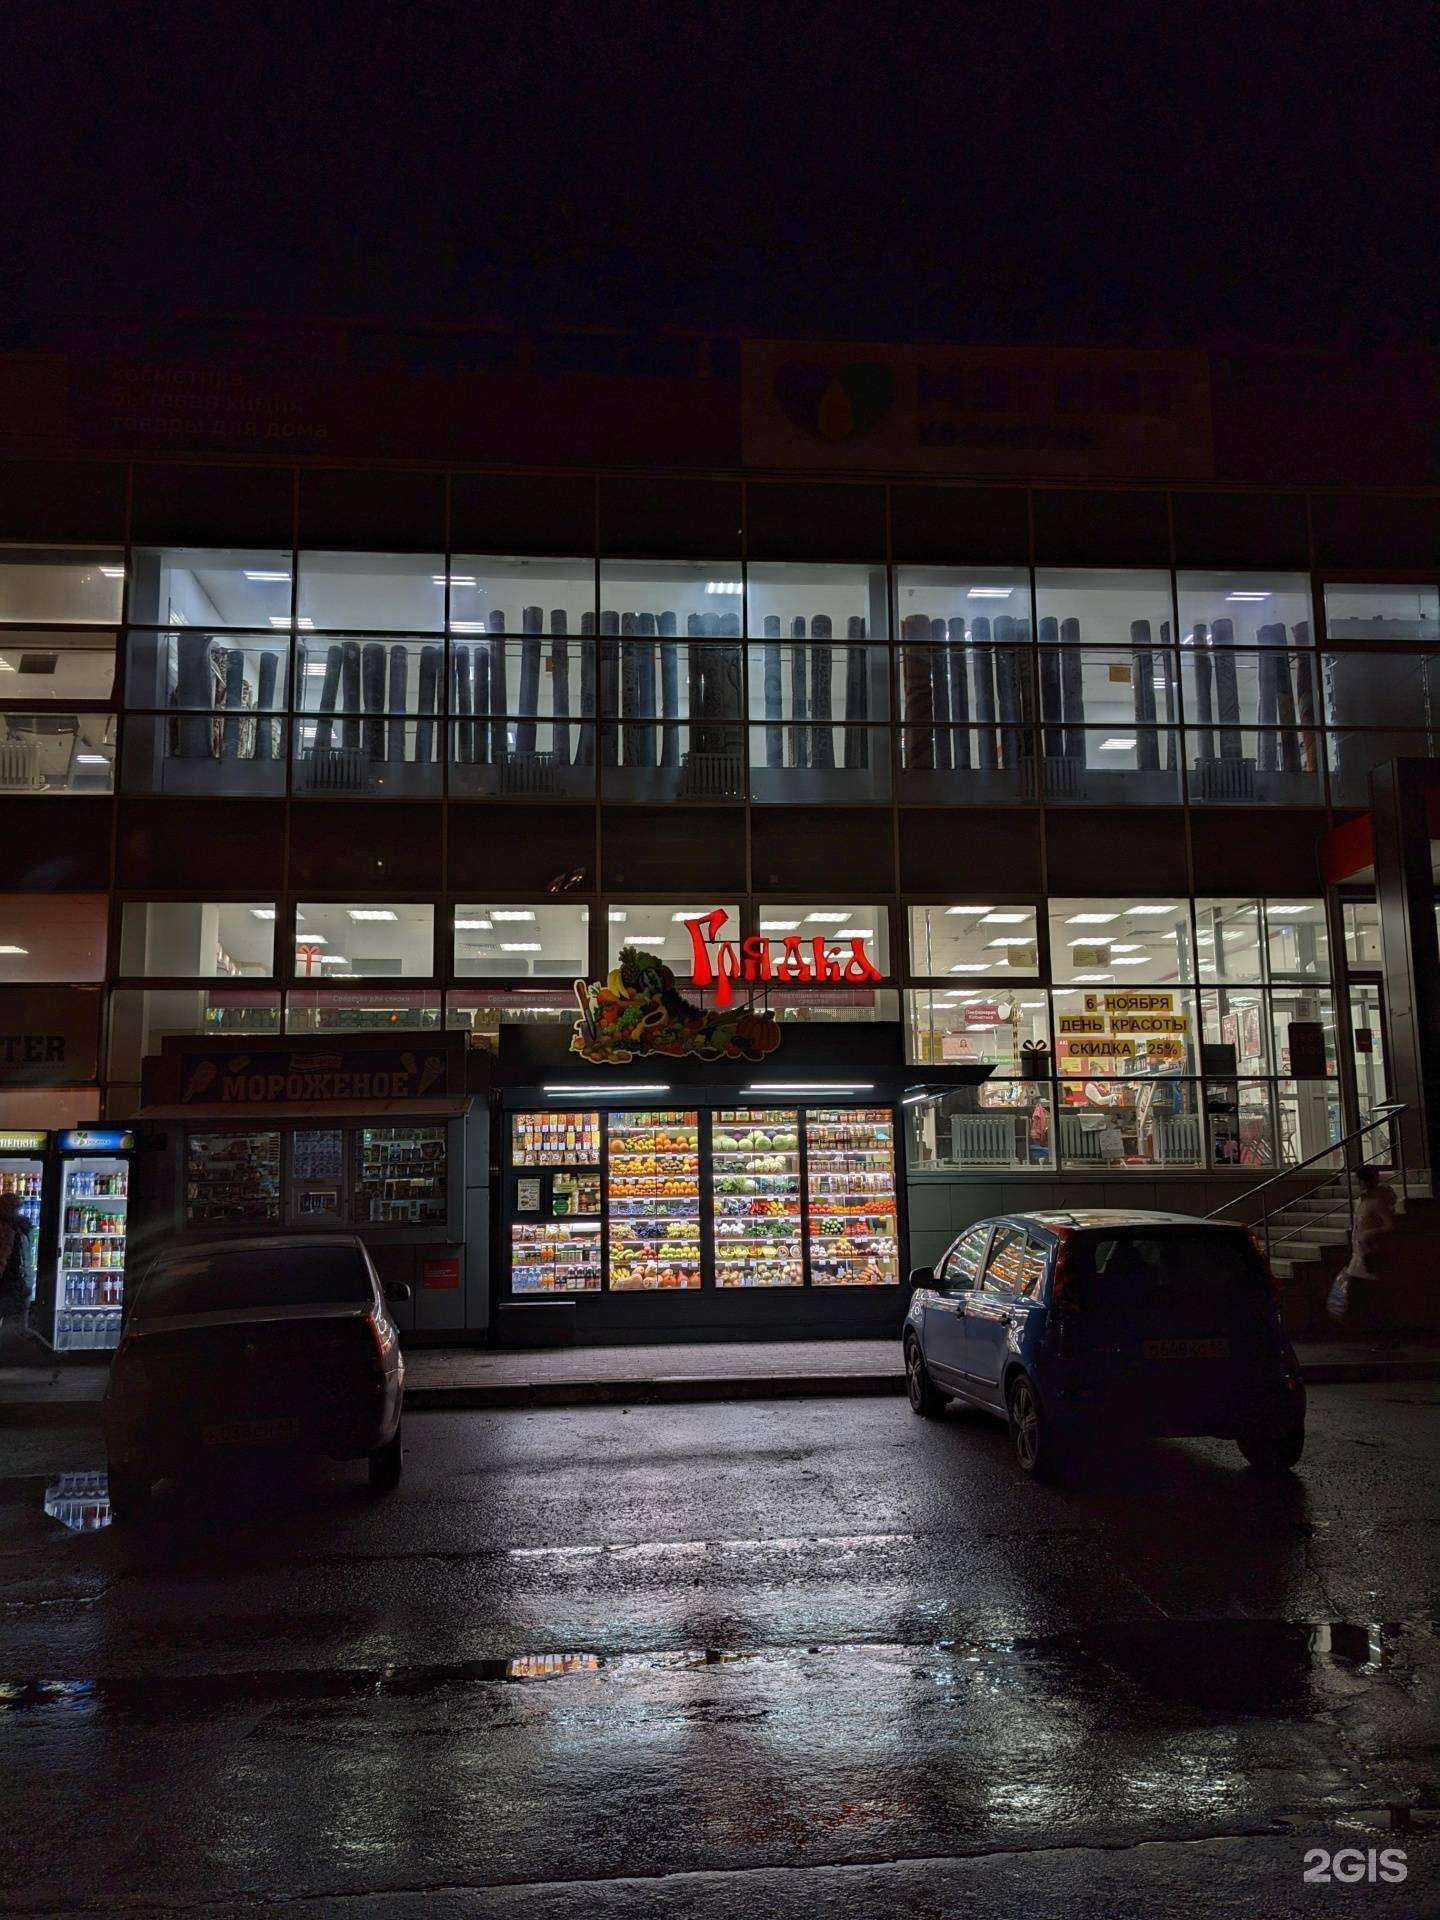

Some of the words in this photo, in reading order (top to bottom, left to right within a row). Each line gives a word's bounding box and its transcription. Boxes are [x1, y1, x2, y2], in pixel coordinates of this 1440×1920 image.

[685, 908, 883, 1007] Грядка
[1086, 998, 1095, 1010] 6
[1106, 997, 1169, 1009] НОЯБРЯ
[1061, 1019, 1102, 1032] ДЕНЬ
[1111, 1018, 1187, 1031] КРАСОТЫ
[1069, 1043, 1131, 1055] СКИДКА
[1148, 1043, 1178, 1055] 25%
[221, 1072, 409, 1102] МОРОЖЕНОЕ
